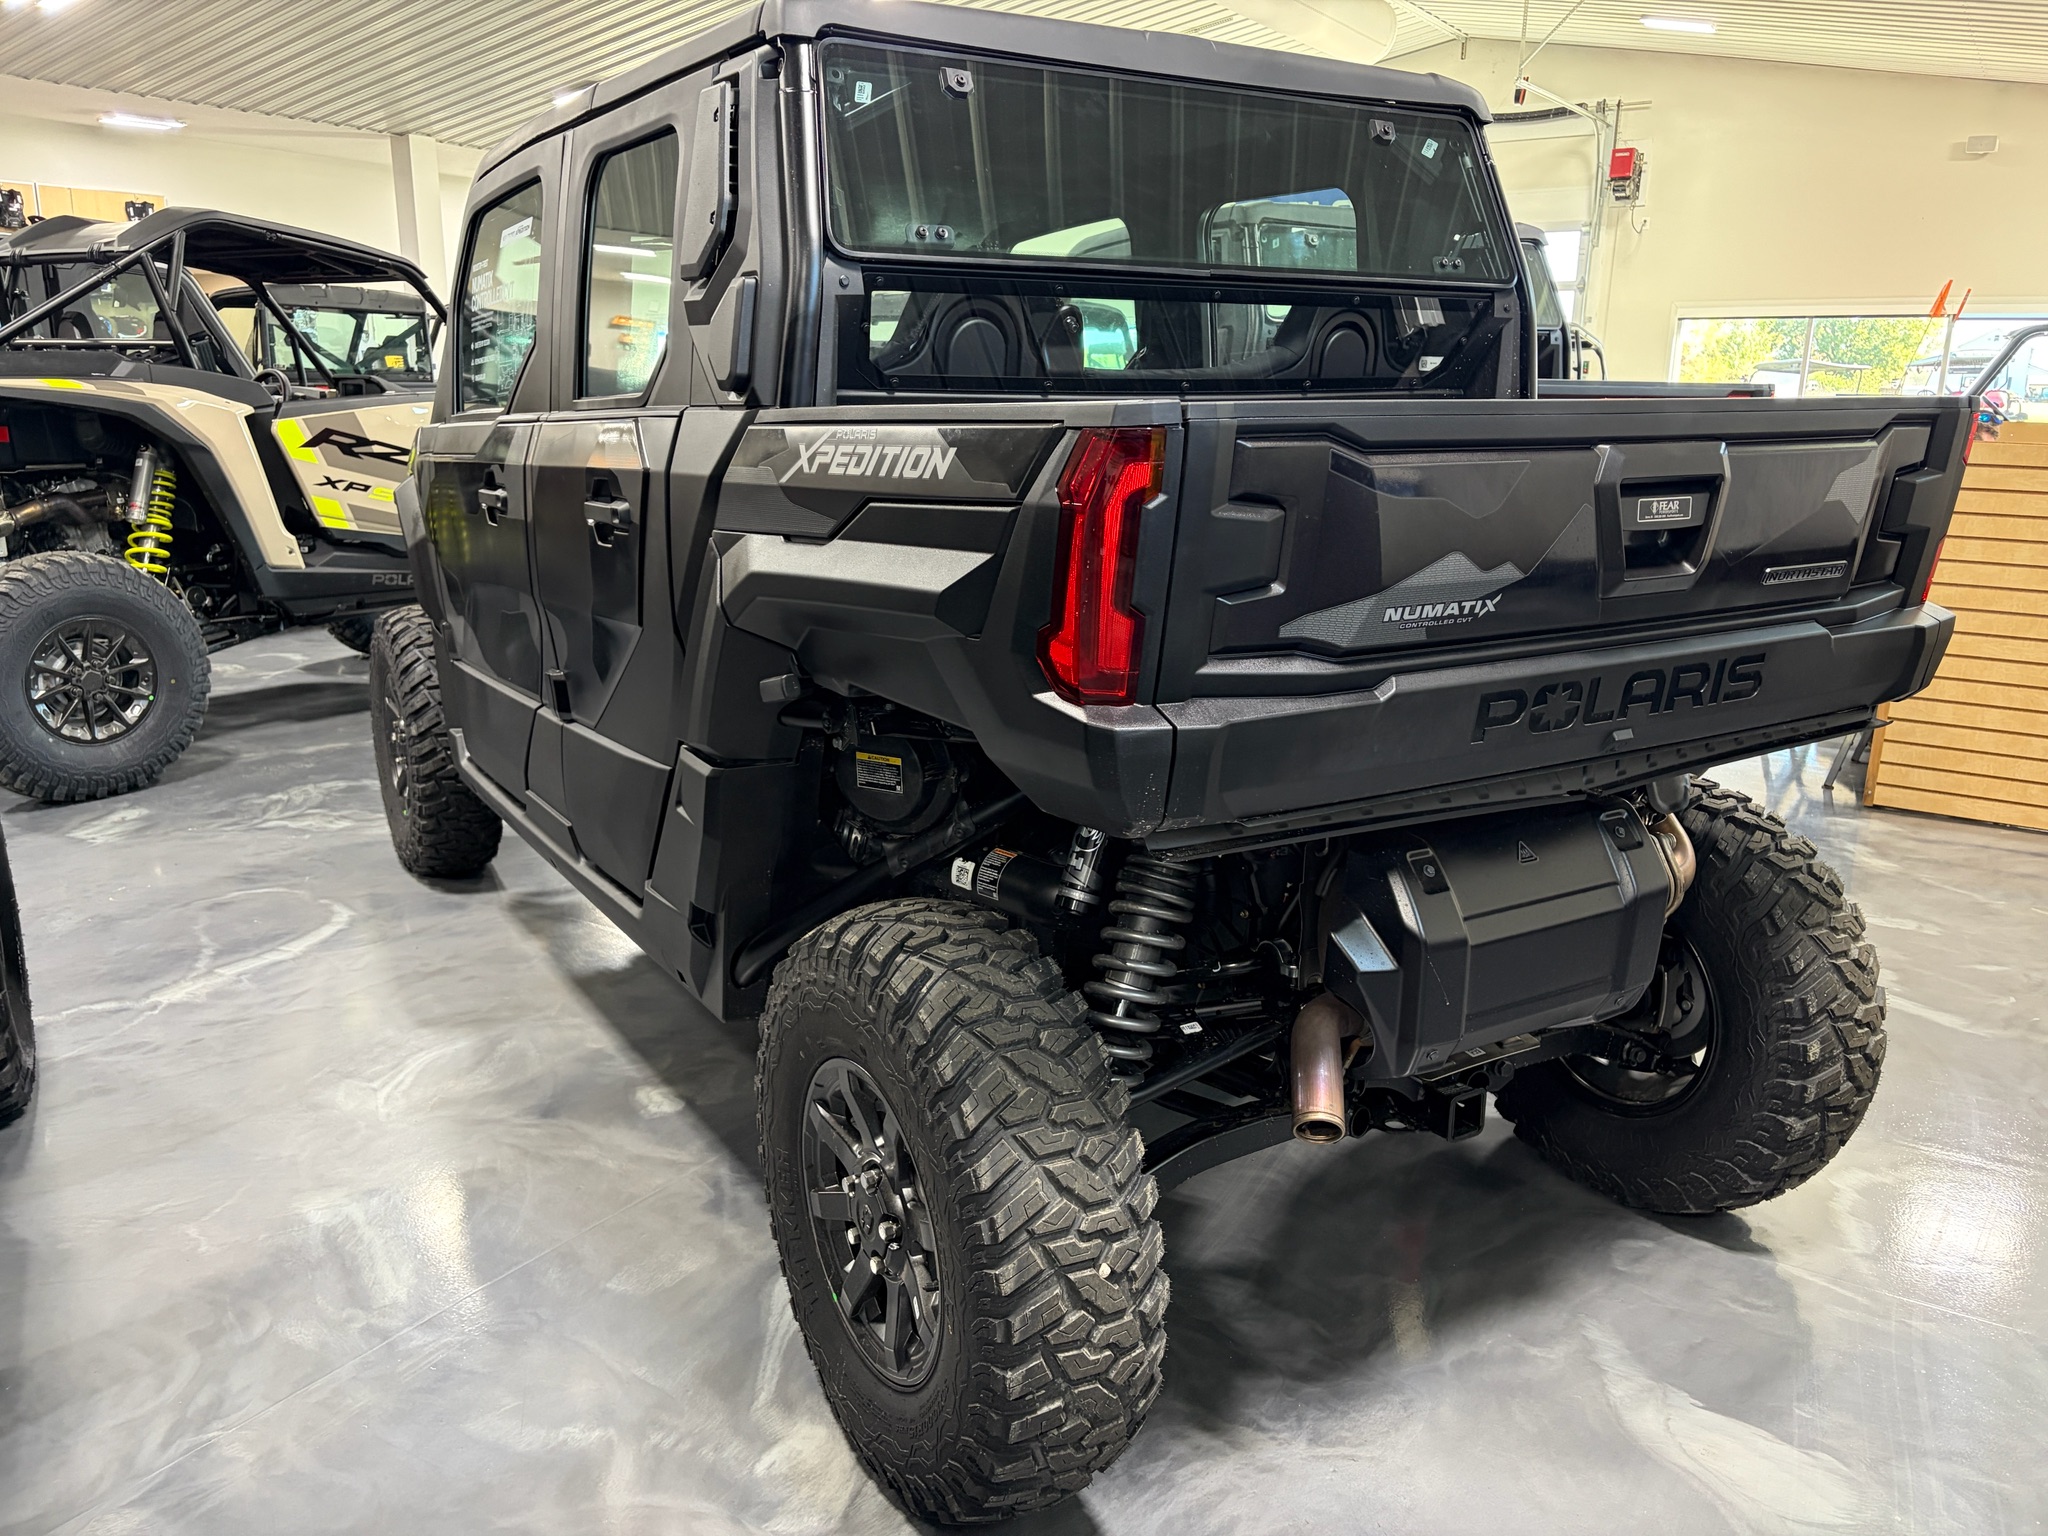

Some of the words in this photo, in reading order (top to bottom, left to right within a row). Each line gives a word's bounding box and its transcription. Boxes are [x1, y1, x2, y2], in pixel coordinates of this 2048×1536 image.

[835, 428, 878, 440] POLARIS
[779, 429, 957, 483] XPEDITION
[1659, 500, 1680, 510] FEAR
[1768, 565, 1844, 582] NORTHSTAR
[1382, 593, 1502, 622] NUMATIX
[1399, 618, 1454, 629] CONTROLLED
[1456, 616, 1474, 624] CVT
[1470, 652, 1766, 744] POLARIS
